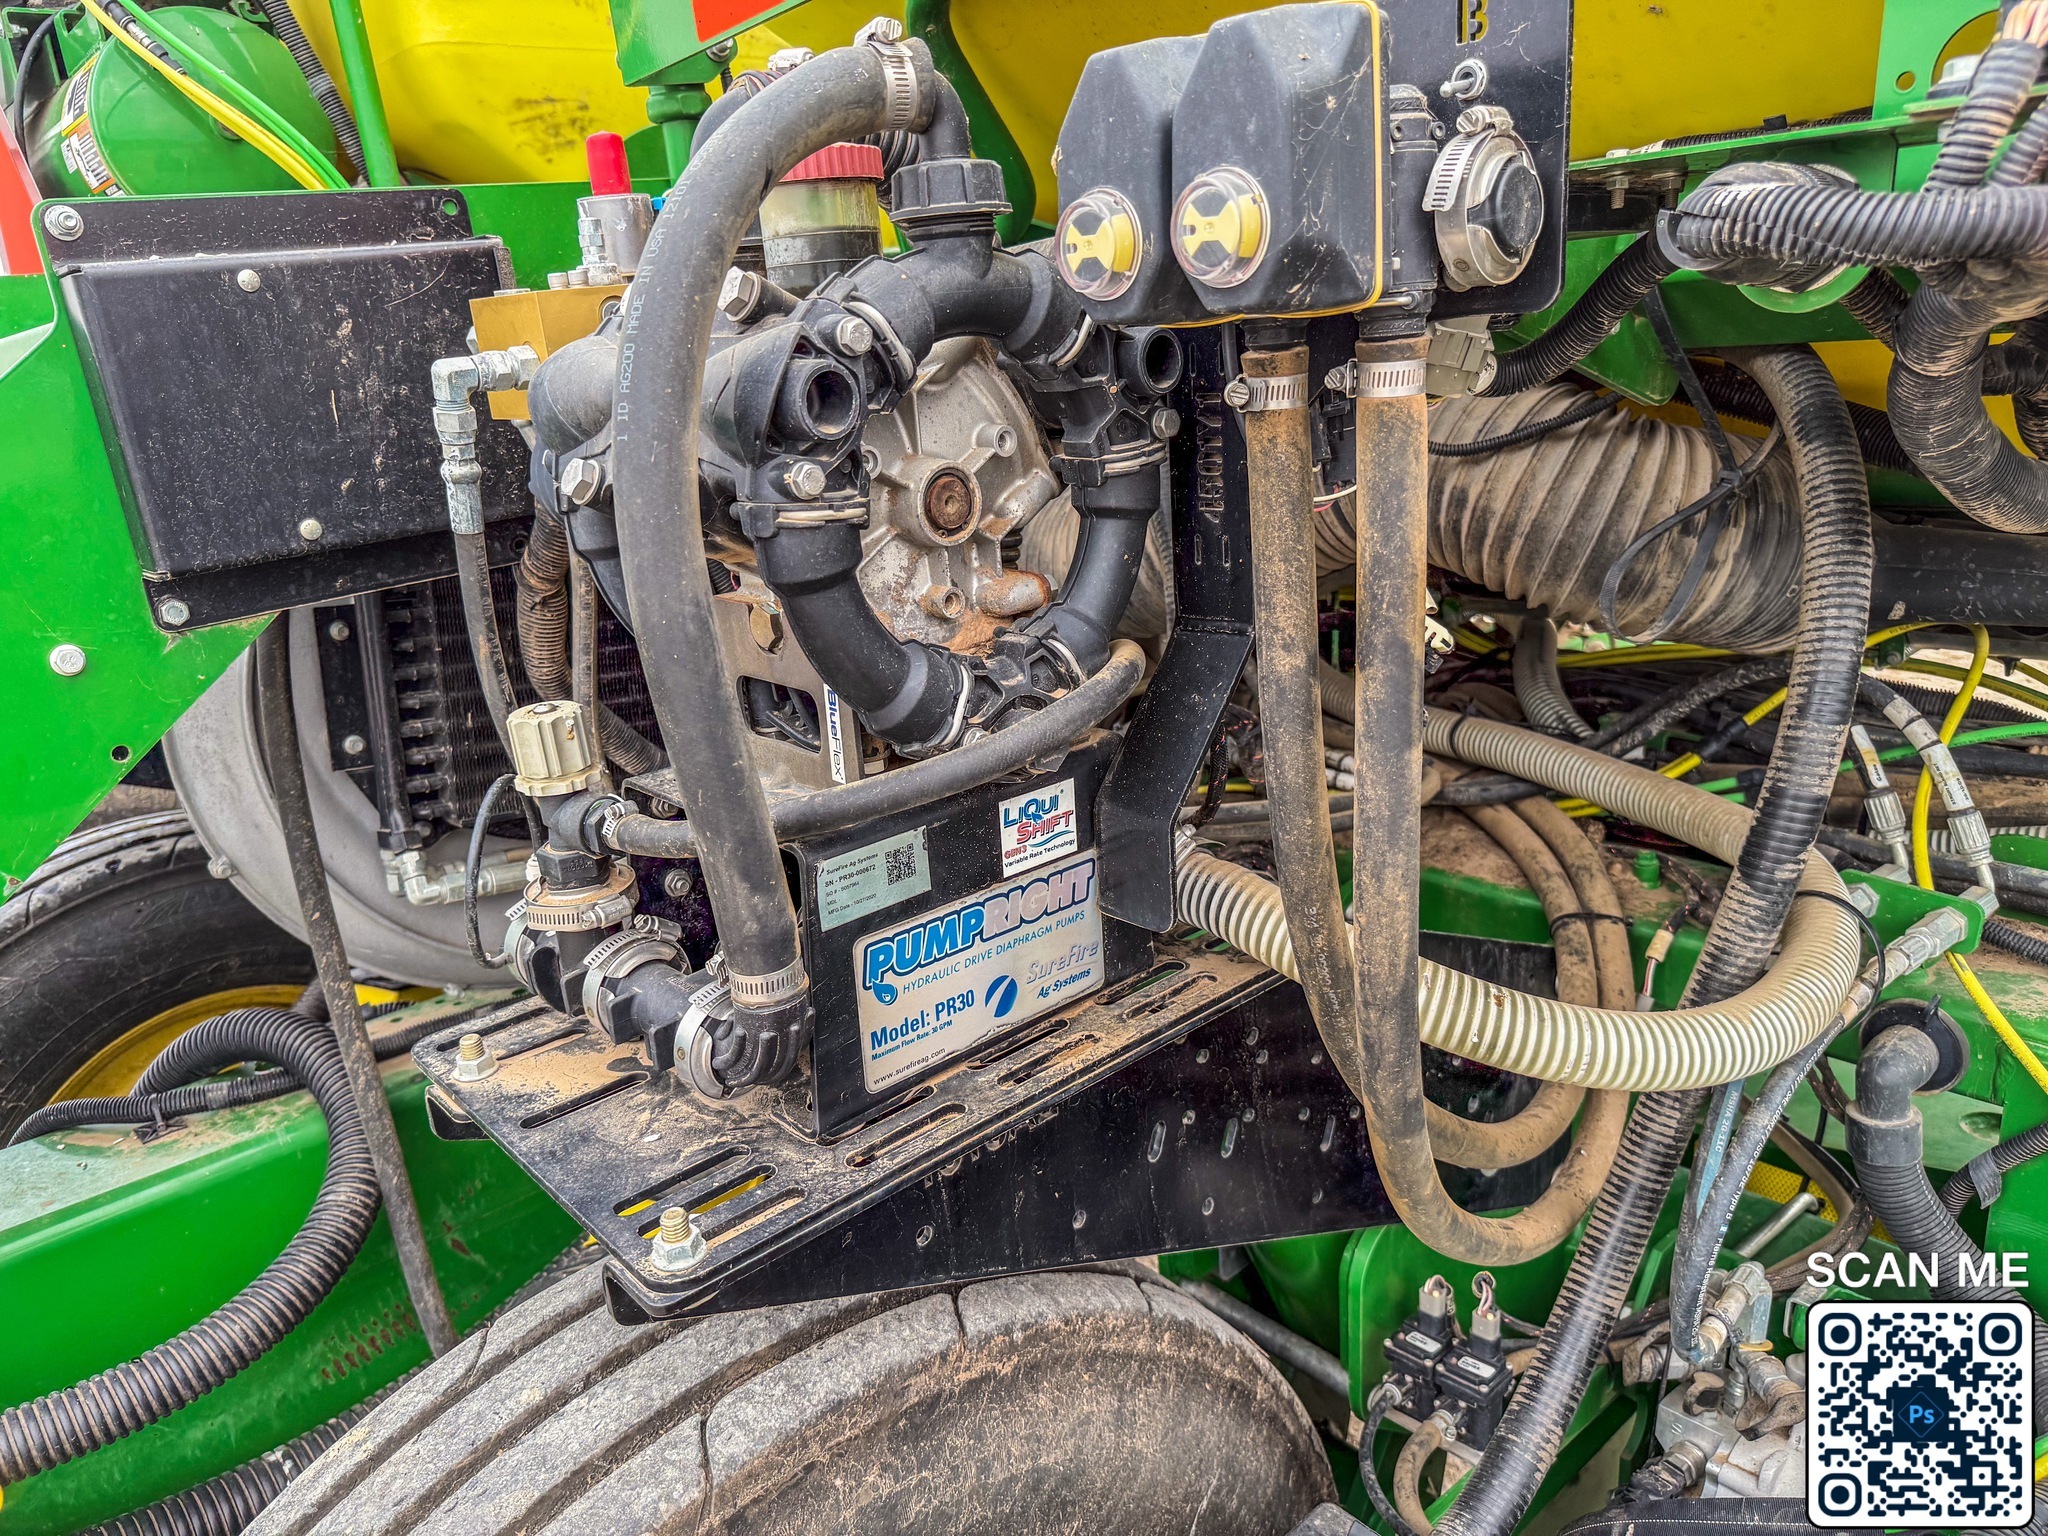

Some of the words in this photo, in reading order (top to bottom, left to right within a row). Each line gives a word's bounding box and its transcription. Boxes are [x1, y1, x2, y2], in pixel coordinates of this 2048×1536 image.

[649, 228, 667, 257] USA
[638, 265, 654, 284] IN
[626, 294, 646, 334] MADE
[620, 343, 635, 393] AG200
[827, 688, 841, 776] BlueFlex
[1004, 794, 1059, 828] LIQUI
[1017, 810, 1074, 845] SHIFT
[826, 864, 848, 875] SureFire
[857, 853, 878, 864] Systems
[1004, 845, 1027, 860] GEN3
[1004, 855, 1028, 867] Variable
[1029, 849, 1043, 859] Rate
[1044, 838, 1075, 854] Technology
[824, 879, 834, 888] SN
[863, 858, 1095, 990] PUMPRIGHT
[903, 961, 961, 994] HYDRAULIC
[964, 948, 993, 969] DRIVE
[996, 924, 1054, 959] DIAPHRAGM
[1056, 911, 1086, 931] PUMPS
[1026, 940, 1099, 984] SureFire
[1037, 985, 1052, 1000] Ag
[1052, 966, 1092, 993] Systems
[870, 1012, 931, 1050] Model:
[935, 989, 976, 1022] PR30
[871, 1043, 900, 1061] Maximum
[901, 1036, 916, 1049] Flow
[916, 1030, 931, 1044] Rate:
[931, 1025, 939, 1035] 30
[939, 1019, 953, 1032] GPM
[872, 1048, 946, 1086] www.surefireag.com
[1725, 1090, 1739, 1118] MSHA
